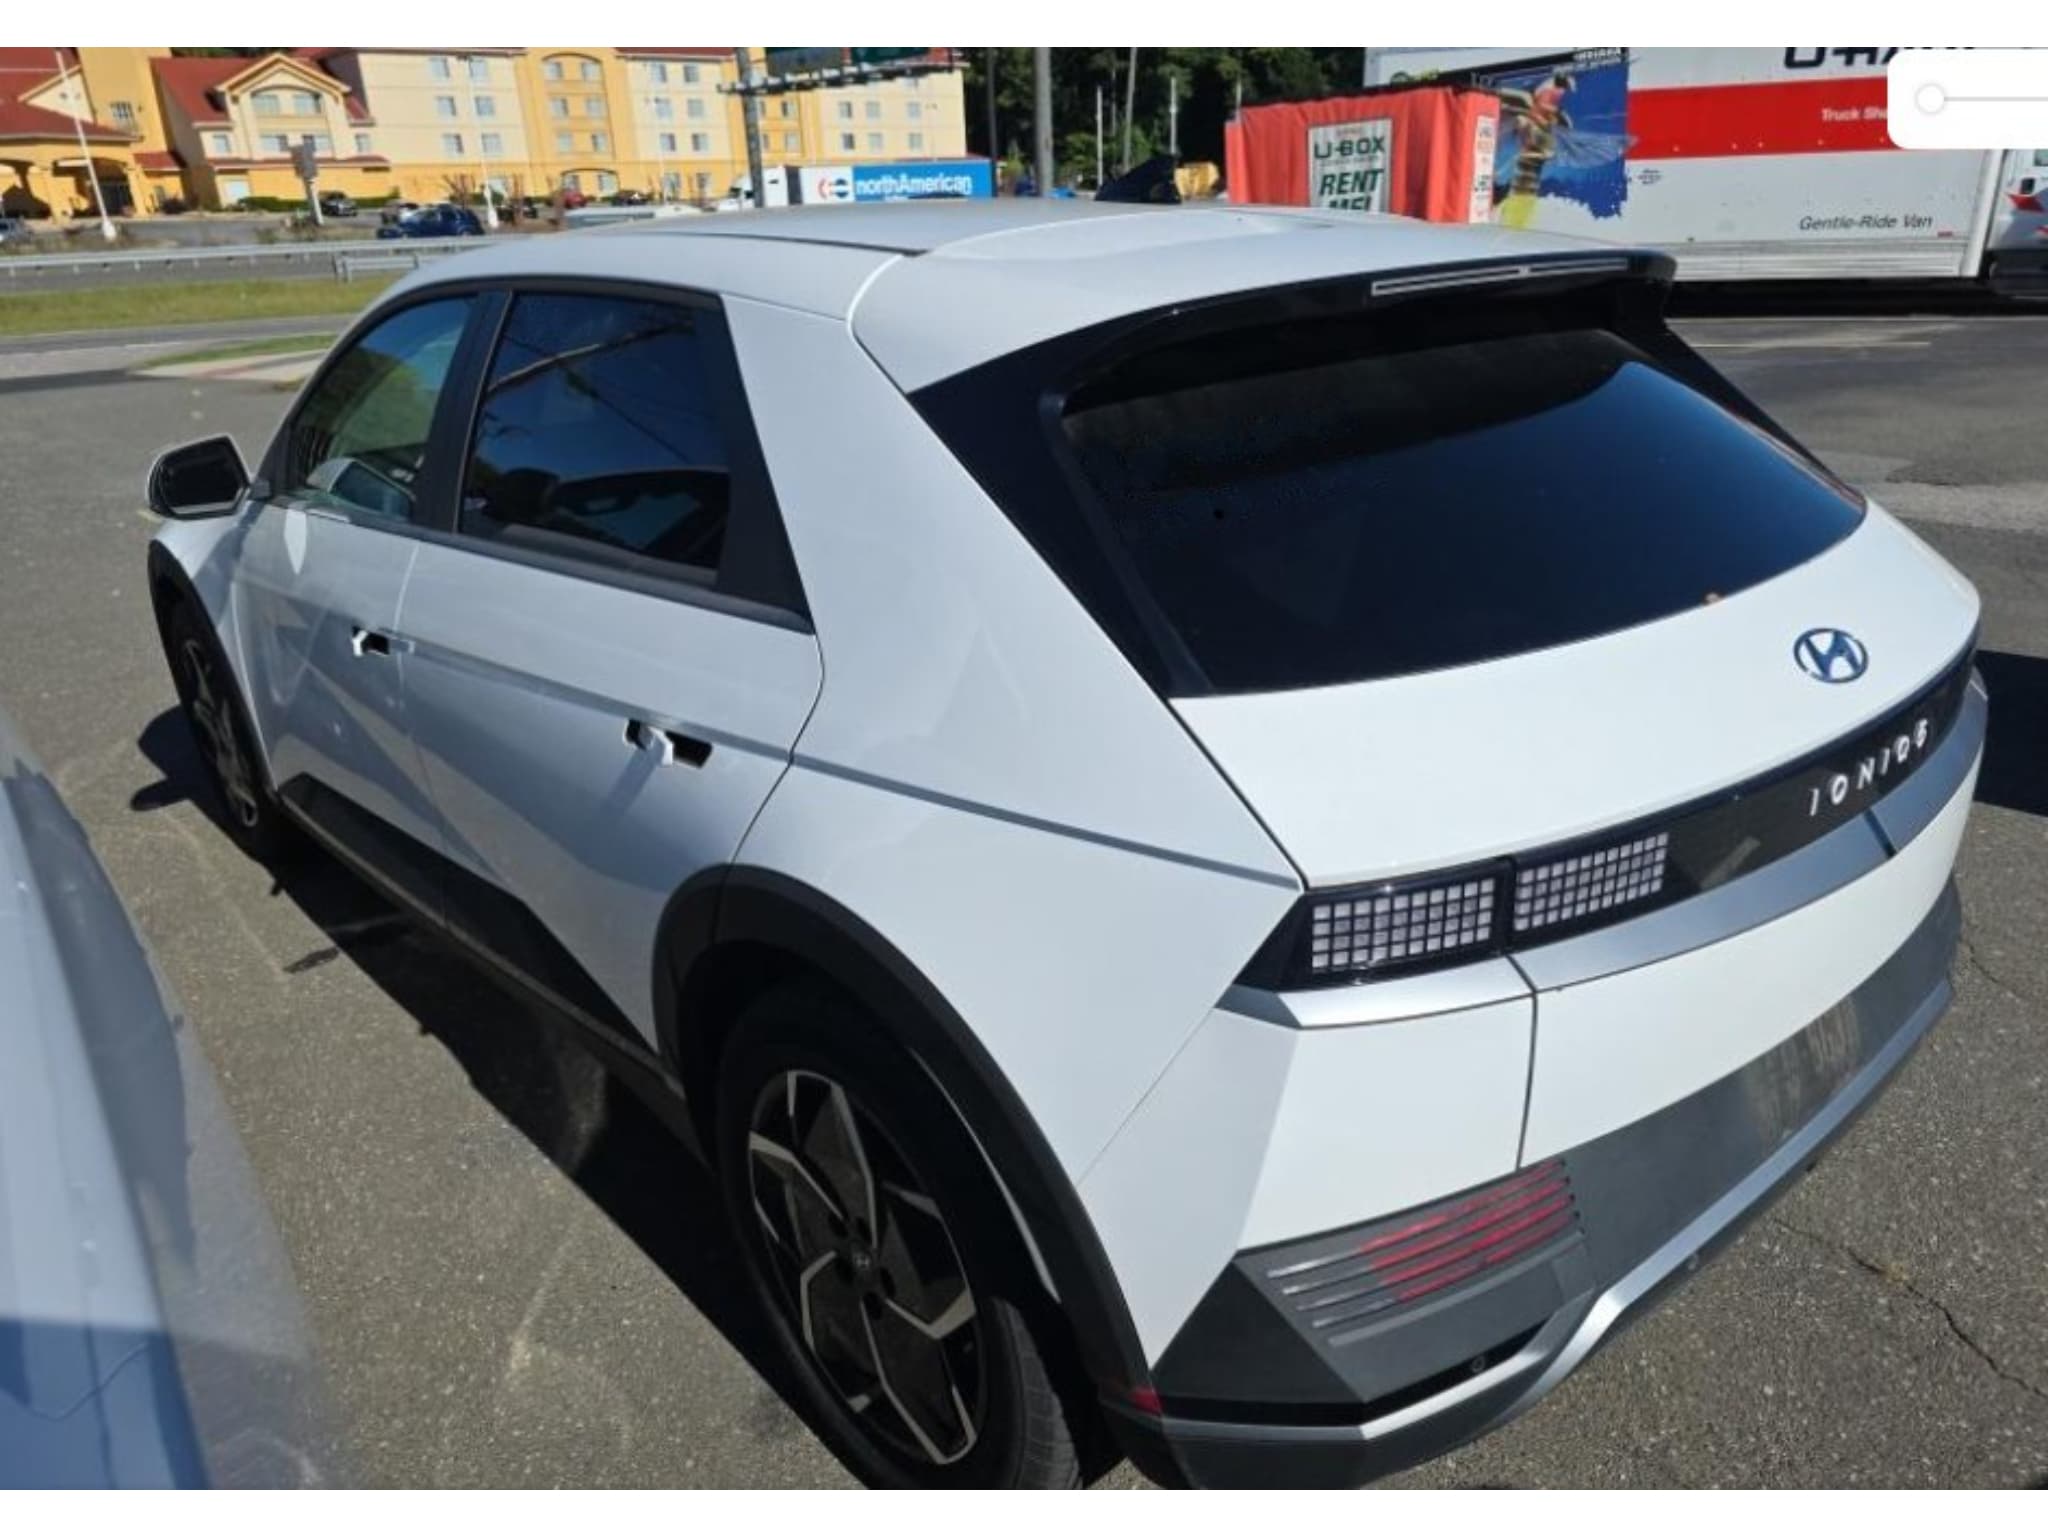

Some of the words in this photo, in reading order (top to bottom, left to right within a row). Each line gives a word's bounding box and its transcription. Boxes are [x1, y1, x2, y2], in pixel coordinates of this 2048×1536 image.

[1821, 107, 1859, 122] Truck
[1314, 136, 1385, 159] U-BOX
[856, 172, 972, 196] northAmerican
[1319, 168, 1384, 197] RENT
[1799, 214, 1898, 231] Gentle-Ride
[1903, 213, 1933, 228] Van
